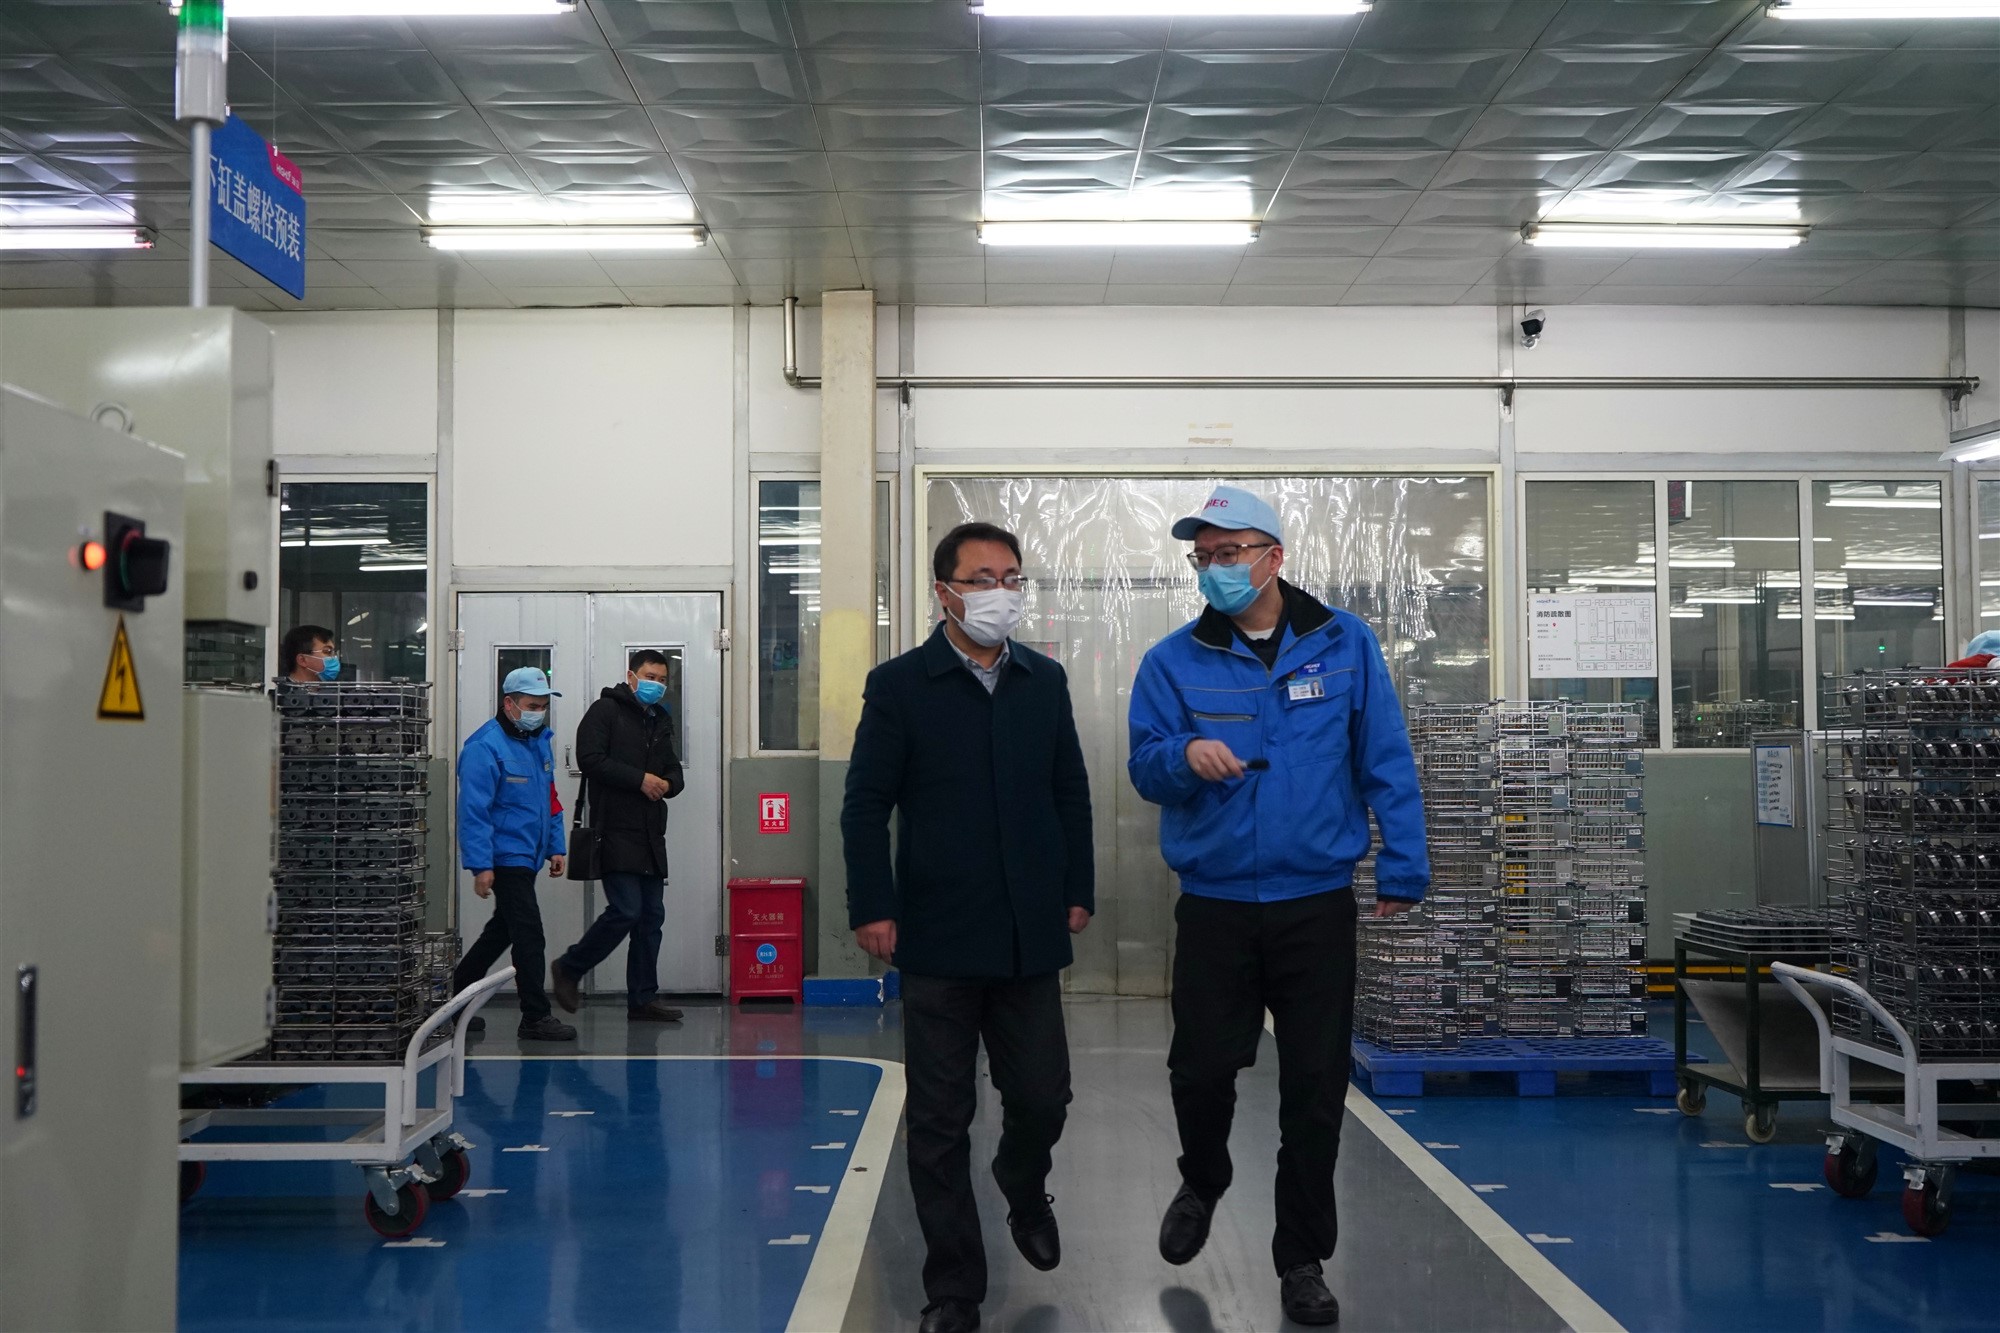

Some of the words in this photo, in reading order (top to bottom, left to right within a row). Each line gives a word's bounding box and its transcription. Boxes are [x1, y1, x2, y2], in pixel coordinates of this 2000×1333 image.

[1536, 610, 1572, 618] 消防疏散图
